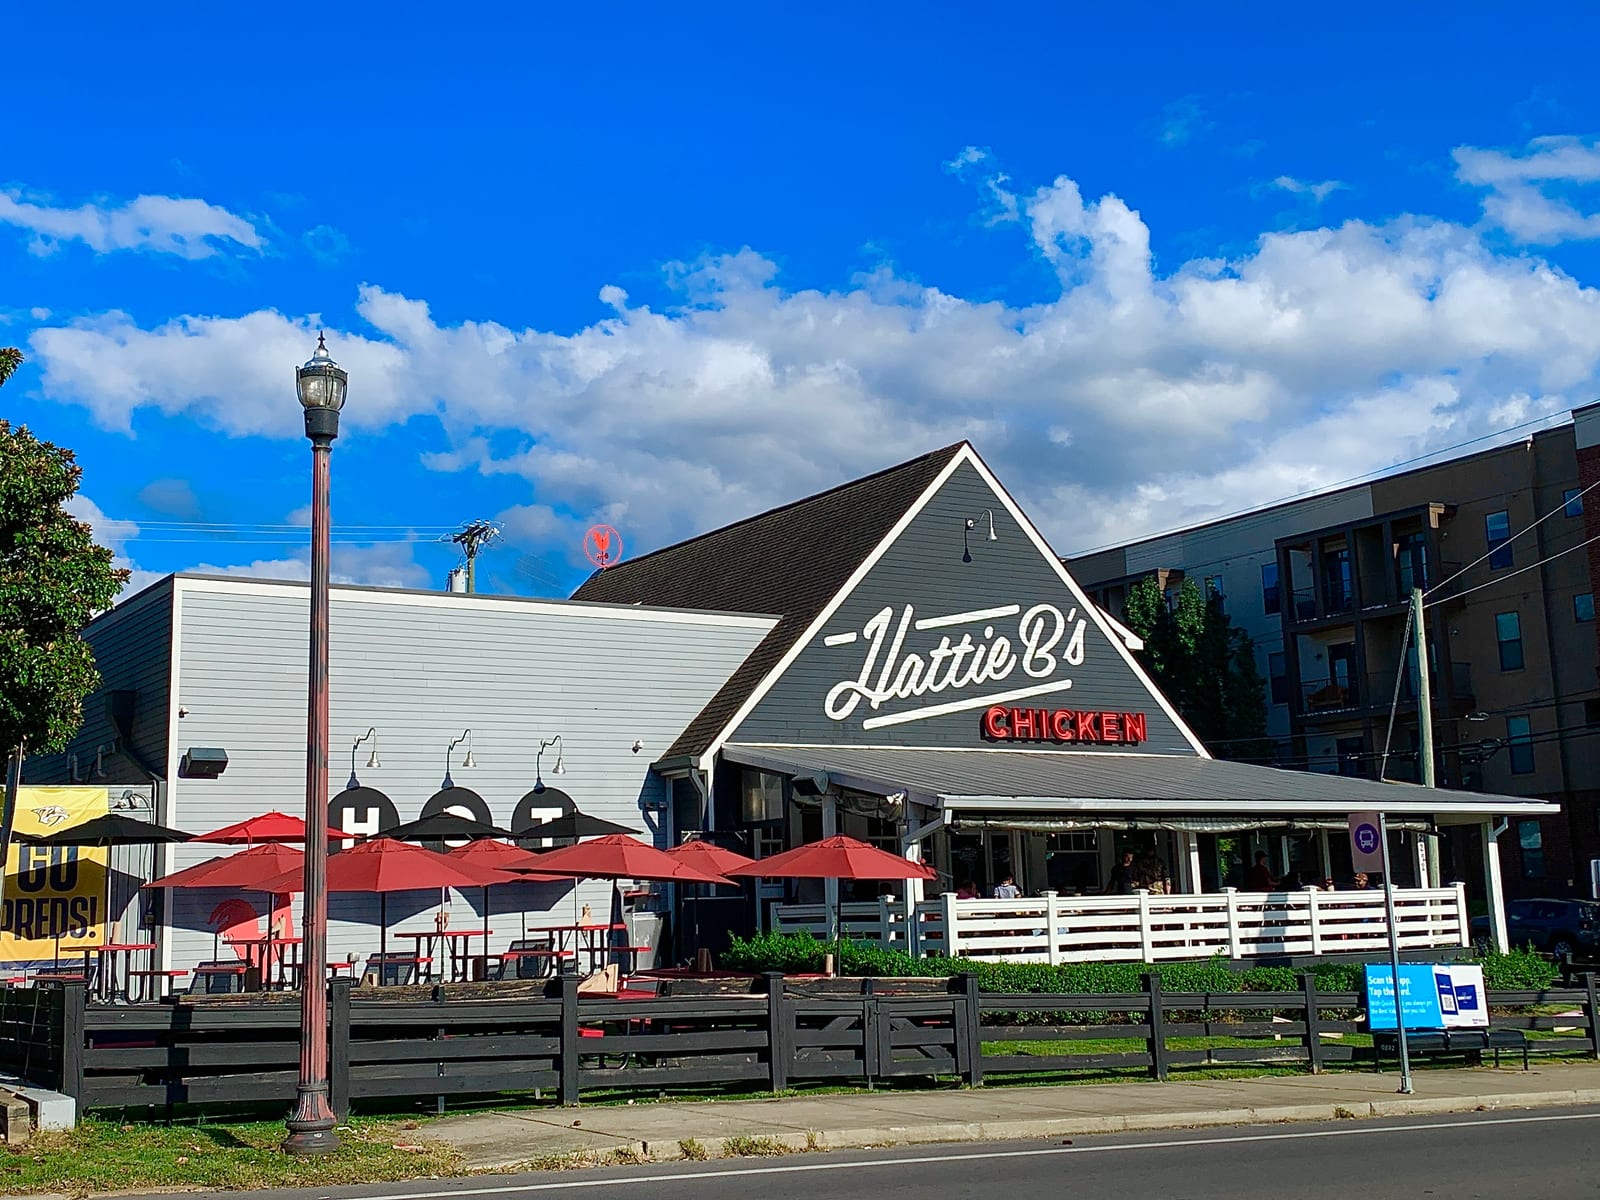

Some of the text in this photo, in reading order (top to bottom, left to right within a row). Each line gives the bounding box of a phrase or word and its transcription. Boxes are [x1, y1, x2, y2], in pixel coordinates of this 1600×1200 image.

[824, 603, 1087, 721] Hattie B's
[981, 706, 1147, 745] CHICKEN
[1368, 975, 1385, 985] Scan
[1368, 987, 1382, 998] Tap
